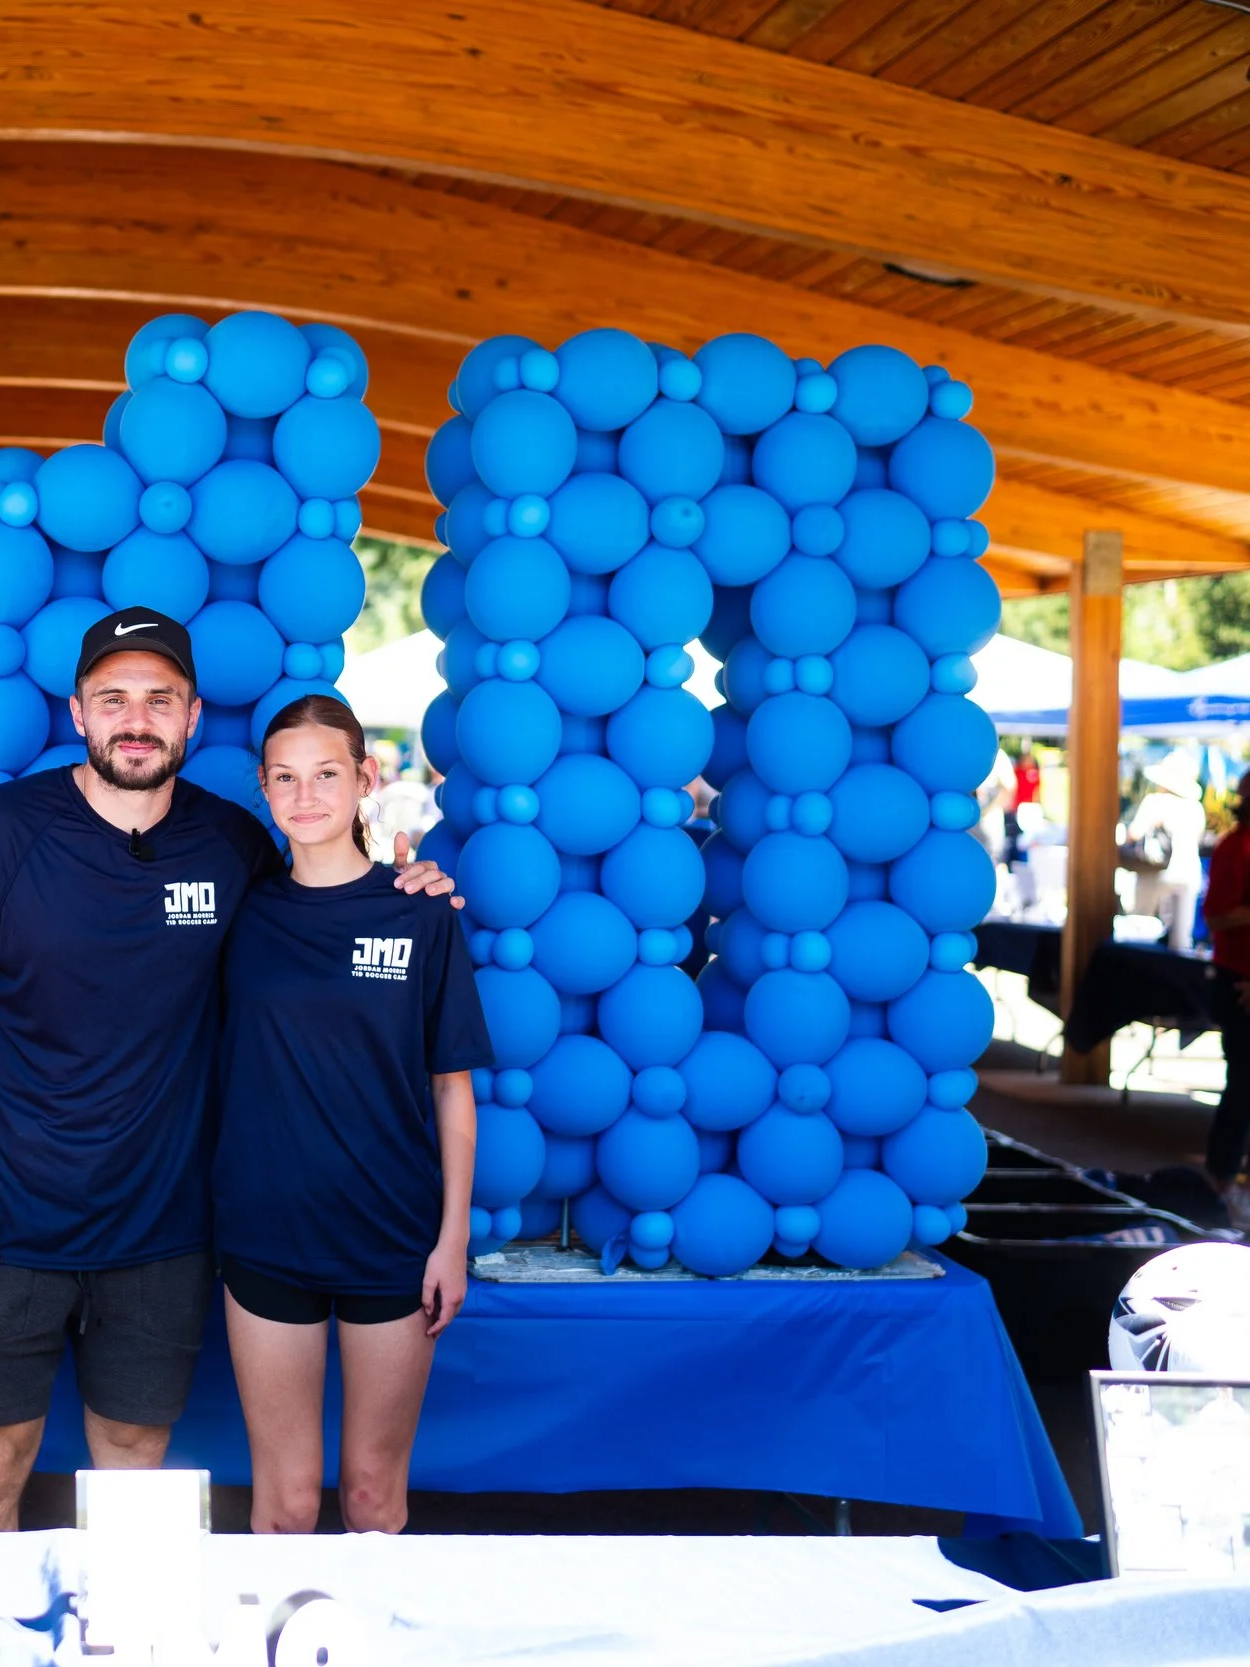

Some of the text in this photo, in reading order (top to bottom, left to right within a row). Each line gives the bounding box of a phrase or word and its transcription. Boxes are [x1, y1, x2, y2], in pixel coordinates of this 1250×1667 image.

[164, 882, 216, 912] JMO
[352, 938, 413, 968] JMO
[354, 965, 406, 975] JORDAN MORRIS
[365, 971, 392, 980] SOCCER
